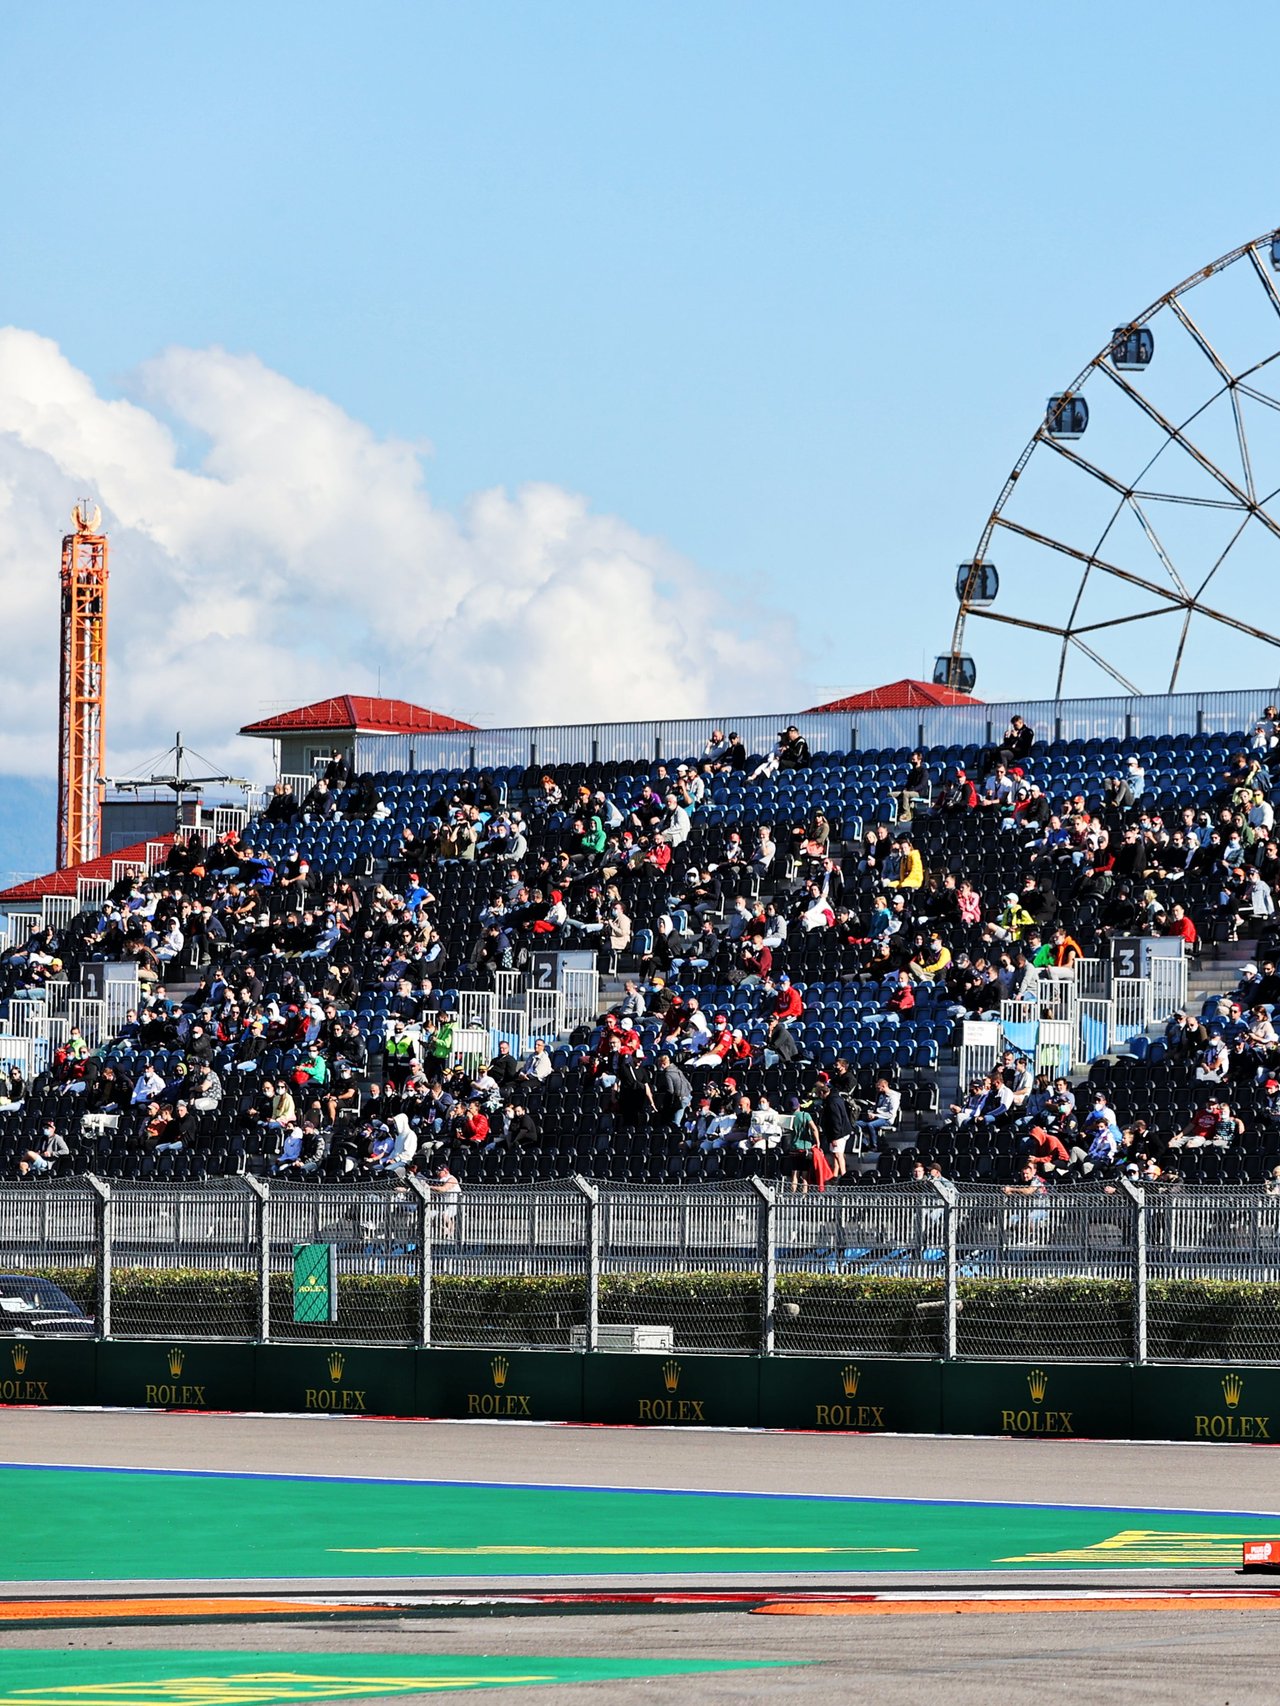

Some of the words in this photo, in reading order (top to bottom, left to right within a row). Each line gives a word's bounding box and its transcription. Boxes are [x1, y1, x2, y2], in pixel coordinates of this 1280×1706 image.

[1119, 949, 1135, 976] 3
[87, 973, 98, 997] 1
[538, 962, 552, 988] 2
[145, 1384, 206, 1405] ROLEX
[305, 1389, 366, 1410] ROLEX
[468, 1394, 531, 1415] ROLEX
[638, 1399, 705, 1421] ROLEX
[816, 1405, 885, 1427] ROLEX
[1001, 1410, 1074, 1433] ROLEX
[1195, 1415, 1270, 1438] ROLEX
